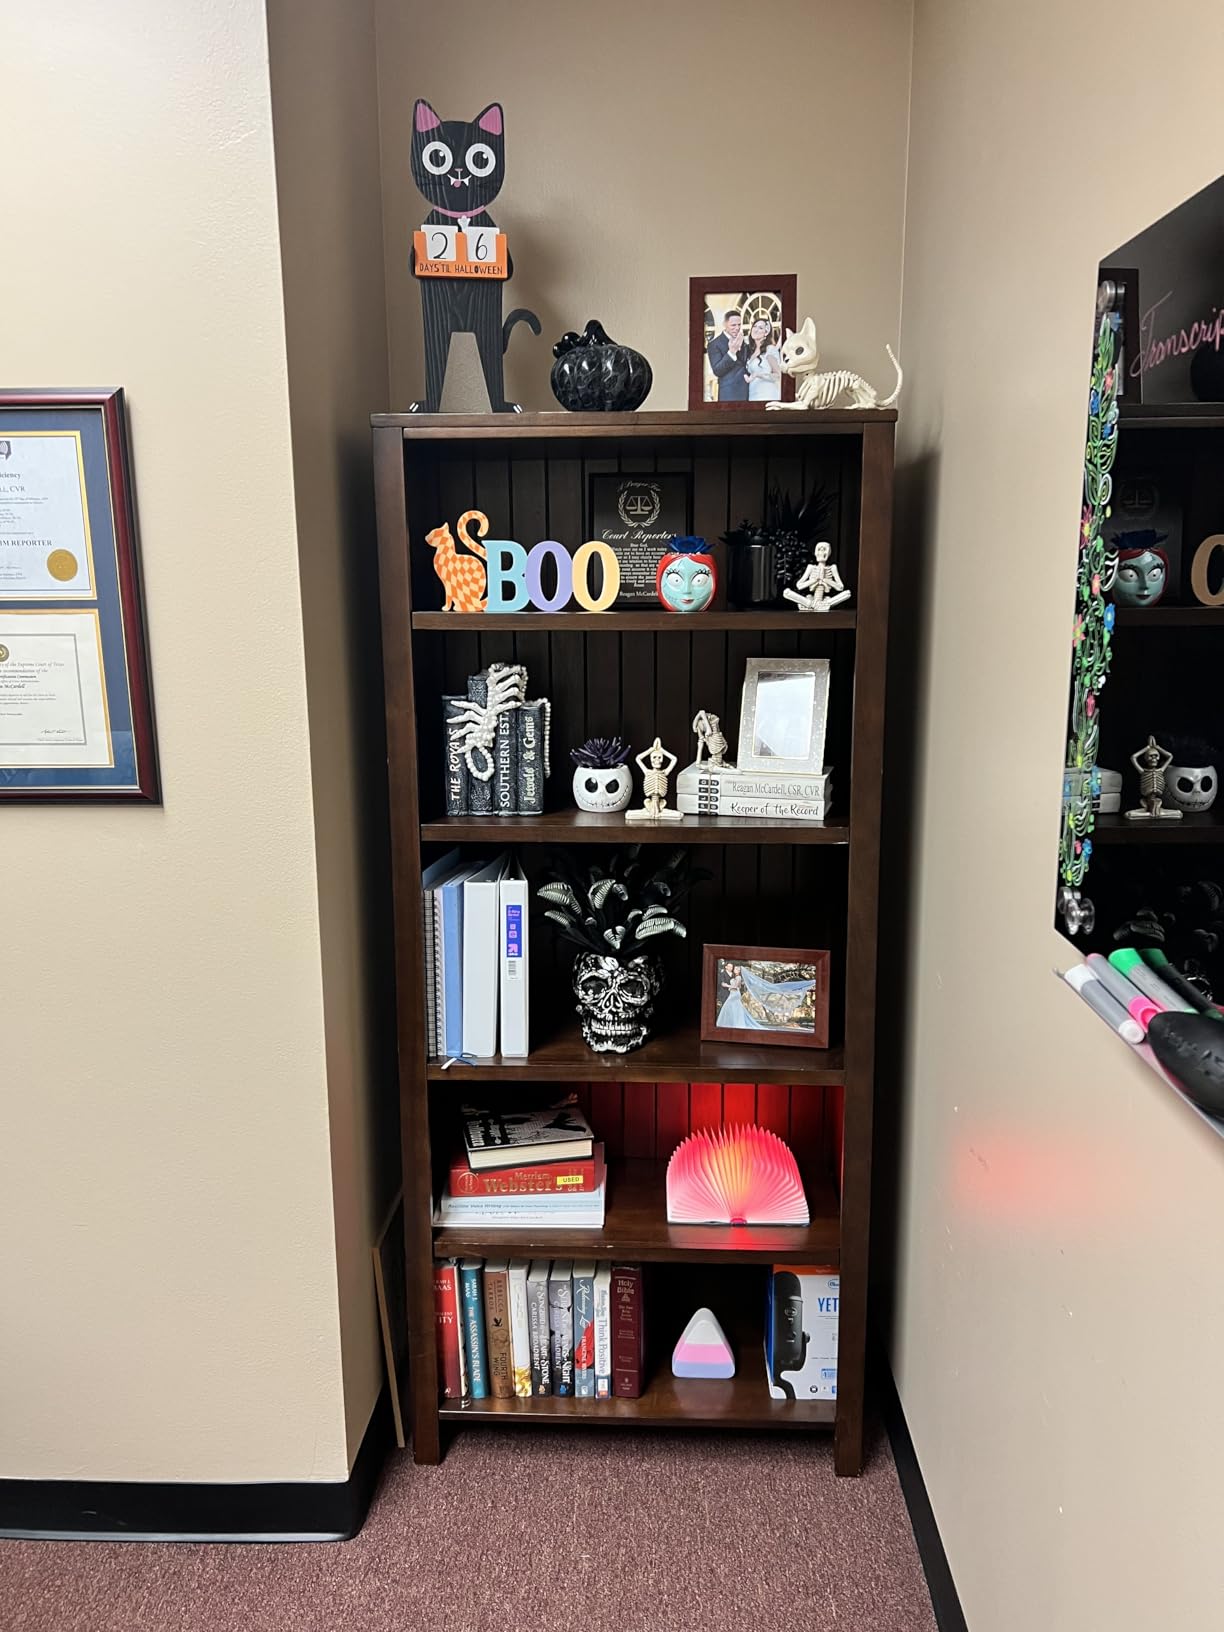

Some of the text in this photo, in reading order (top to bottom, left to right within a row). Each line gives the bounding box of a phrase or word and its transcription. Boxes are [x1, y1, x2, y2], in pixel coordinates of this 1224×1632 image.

[431, 232, 488, 261] 2 6
[420, 263, 440, 273] DAYS
[455, 264, 503, 275] HALLOWEEN
[602, 529, 629, 539] Court
[482, 540, 620, 612] BOO
[523, 716, 536, 748] Gems
[449, 728, 461, 801] THE ROYAS
[500, 711, 510, 808] SOUTHERN EST
[523, 767, 536, 804] Jewels
[732, 782, 753, 795] Reagan
[755, 783, 786, 796] McCardell,
[804, 785, 820, 798] CVR
[731, 802, 819, 816] Keeper of the Record
[618, 1280, 633, 1288] Holy
[818, 1297, 839, 1312] YET
[438, 1316, 453, 1324] ITY
[598, 1320, 608, 1342] Think
[470, 1320, 479, 1359] ASSASSIN'S
[532, 1331, 540, 1370] BROADBENT
[473, 1360, 481, 1382] BLADE
[598, 1343, 608, 1375] Positive
[541, 1360, 550, 1384] STONE
